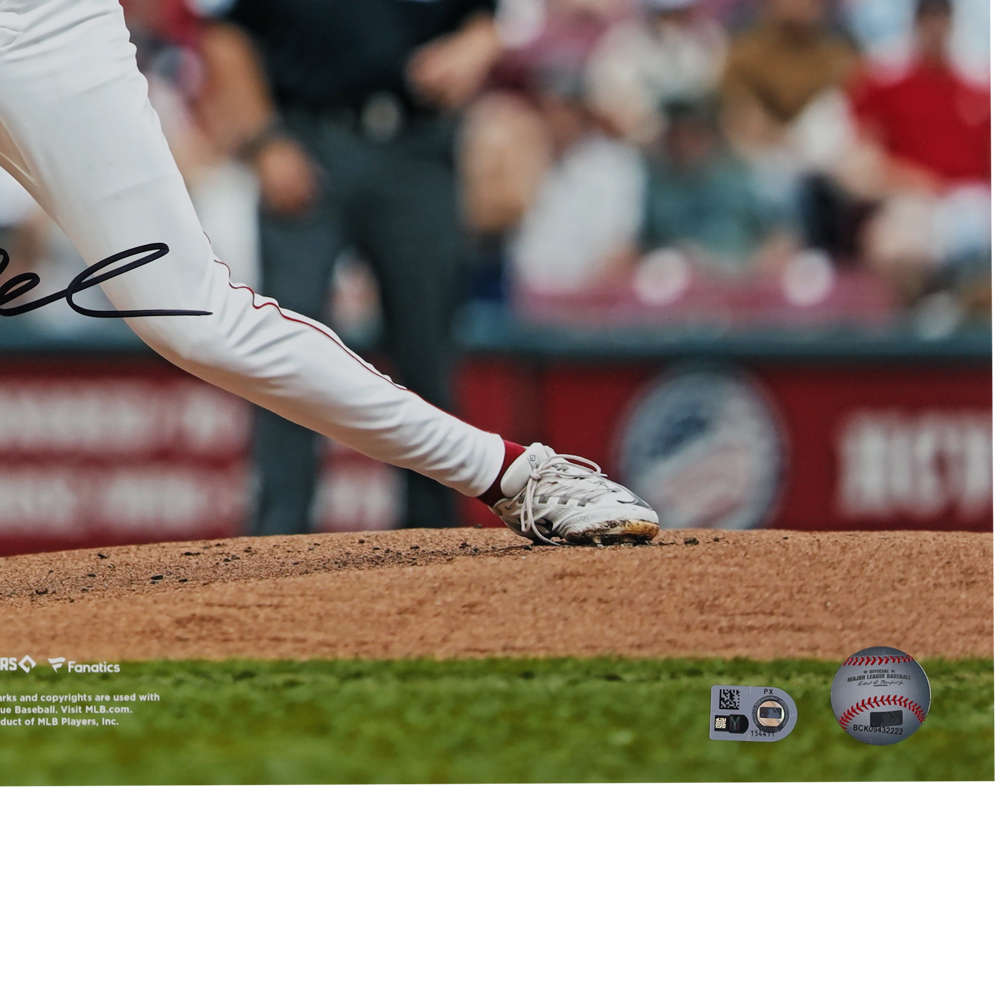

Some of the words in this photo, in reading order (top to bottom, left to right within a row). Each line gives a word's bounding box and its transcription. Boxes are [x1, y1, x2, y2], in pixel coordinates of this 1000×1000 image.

[68, 661, 121, 673] Fanatics
[847, 674, 866, 683] MAJOR
[19, 694, 38, 702] and
[40, 694, 93, 703] copyrights
[113, 693, 136, 701] used
[138, 693, 161, 701] with
[14, 706, 58, 714] Baseball.
[60, 706, 83, 714] Visit
[85, 706, 133, 714] MLB.com.
[24, 717, 35, 726] of
[37, 717, 59, 726] MLB
[61, 717, 99, 727] Players,
[101, 717, 119, 726] Inc.
